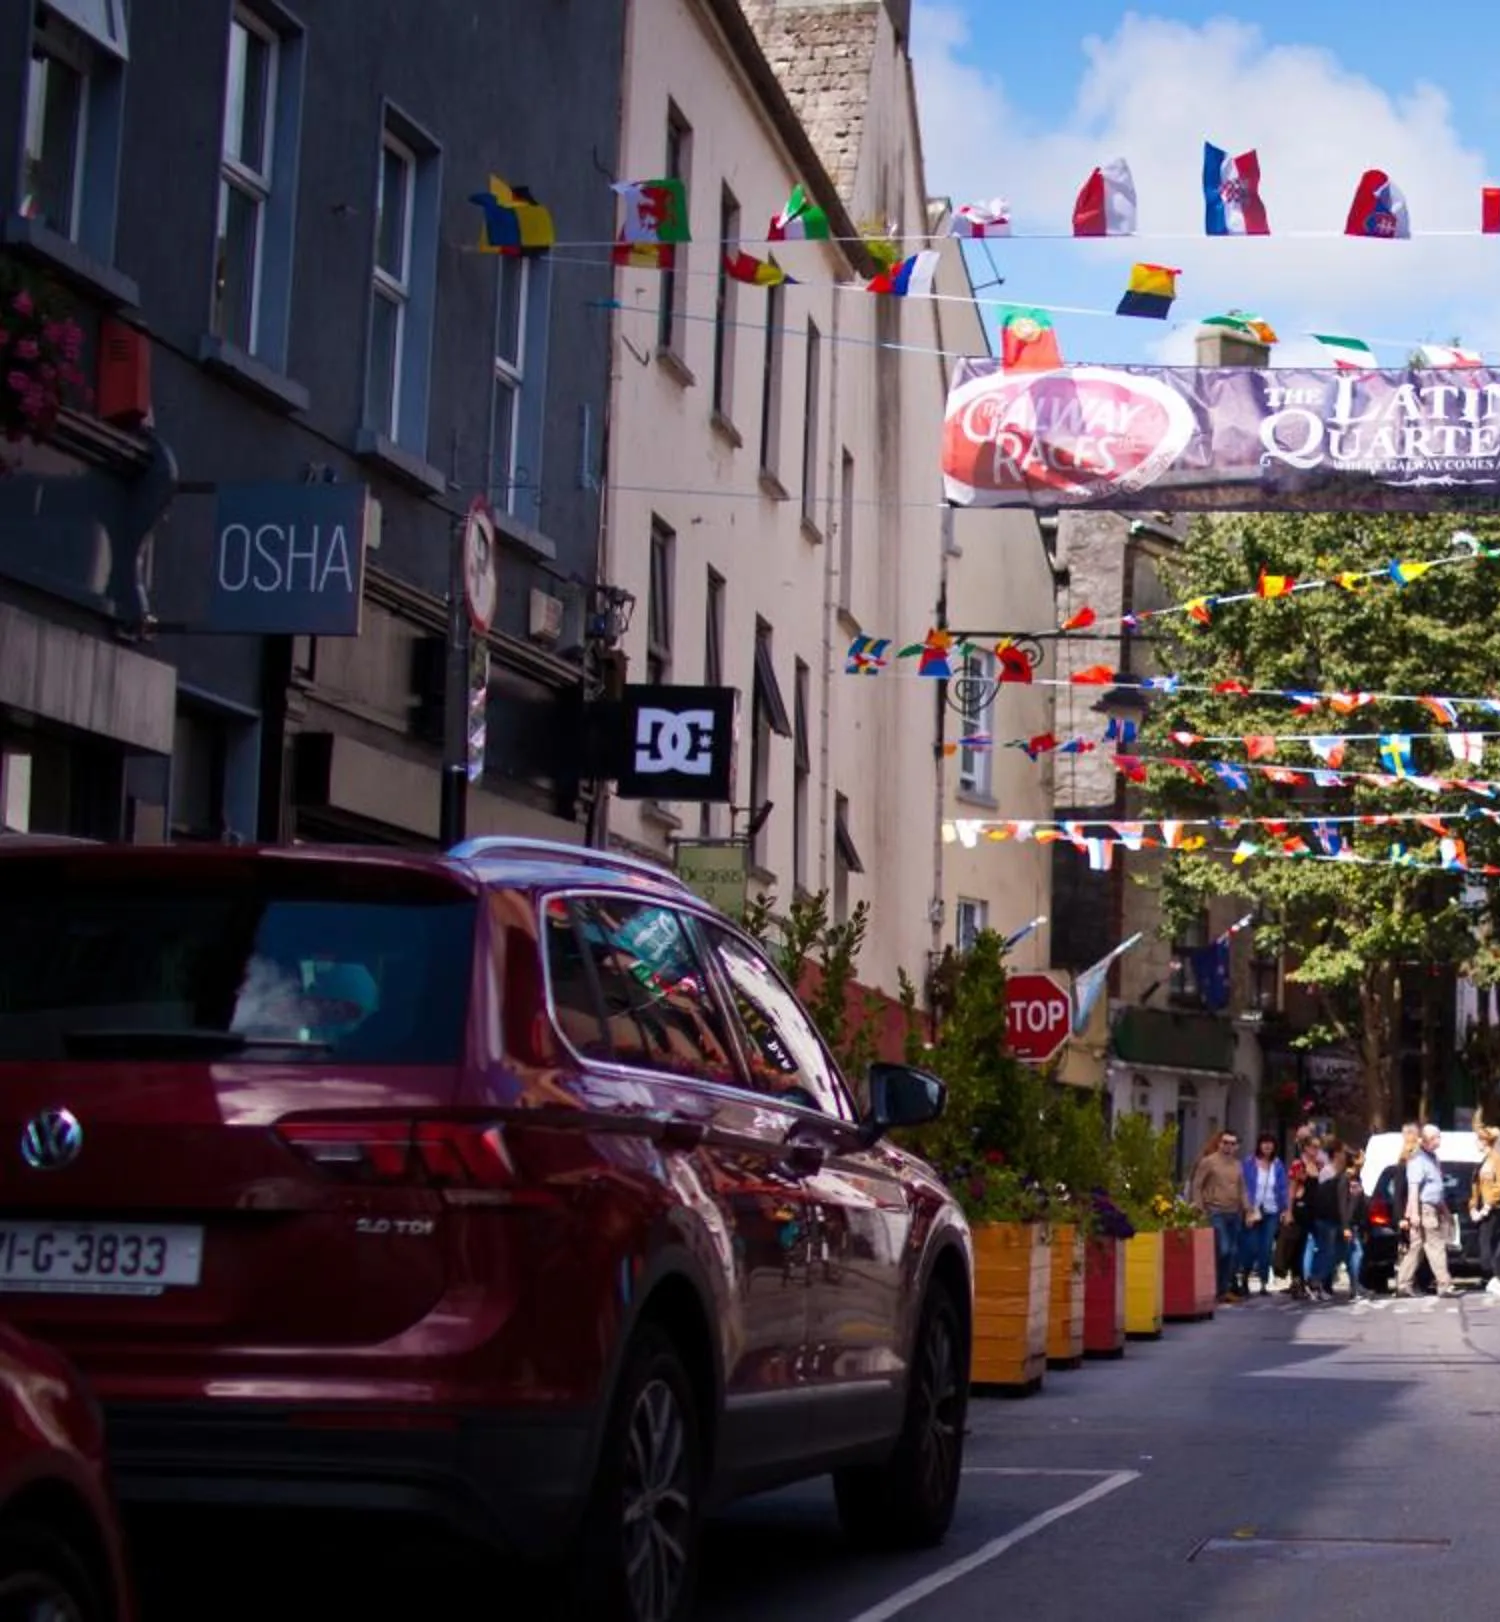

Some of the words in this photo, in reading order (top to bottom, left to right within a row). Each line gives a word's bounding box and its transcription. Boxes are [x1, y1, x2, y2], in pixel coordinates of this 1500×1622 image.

[961, 391, 1146, 443] GALWAY
[1263, 387, 1324, 407] THE
[993, 430, 1118, 484] RACES
[1386, 458, 1443, 471] GALWAY
[1444, 458, 1495, 471] COMES
[218, 523, 353, 593] OSHA
[1005, 999, 1065, 1033] TOP
